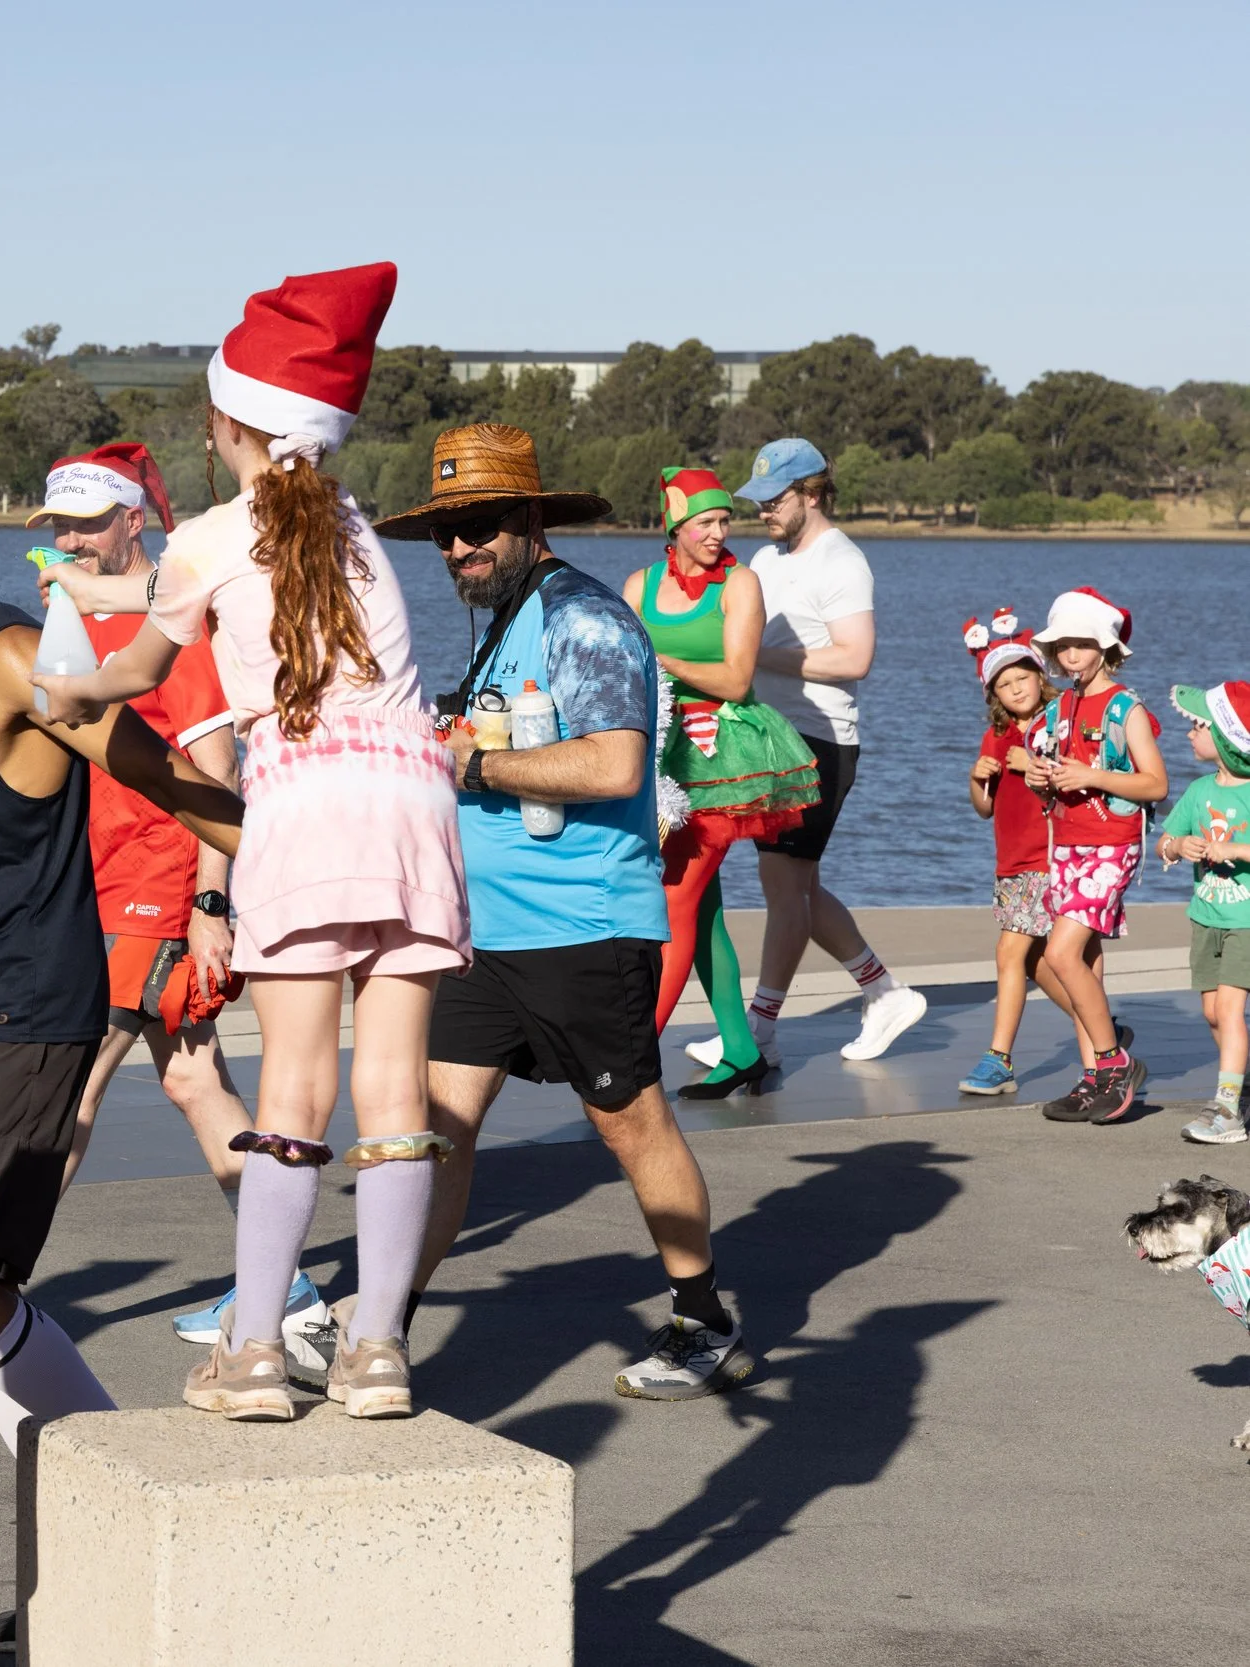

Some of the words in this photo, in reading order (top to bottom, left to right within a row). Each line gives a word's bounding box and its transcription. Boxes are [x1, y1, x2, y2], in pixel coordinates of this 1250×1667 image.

[66, 466, 102, 483] Santa
[103, 473, 124, 491] Run
[136, 904, 162, 912] CAPITAL
